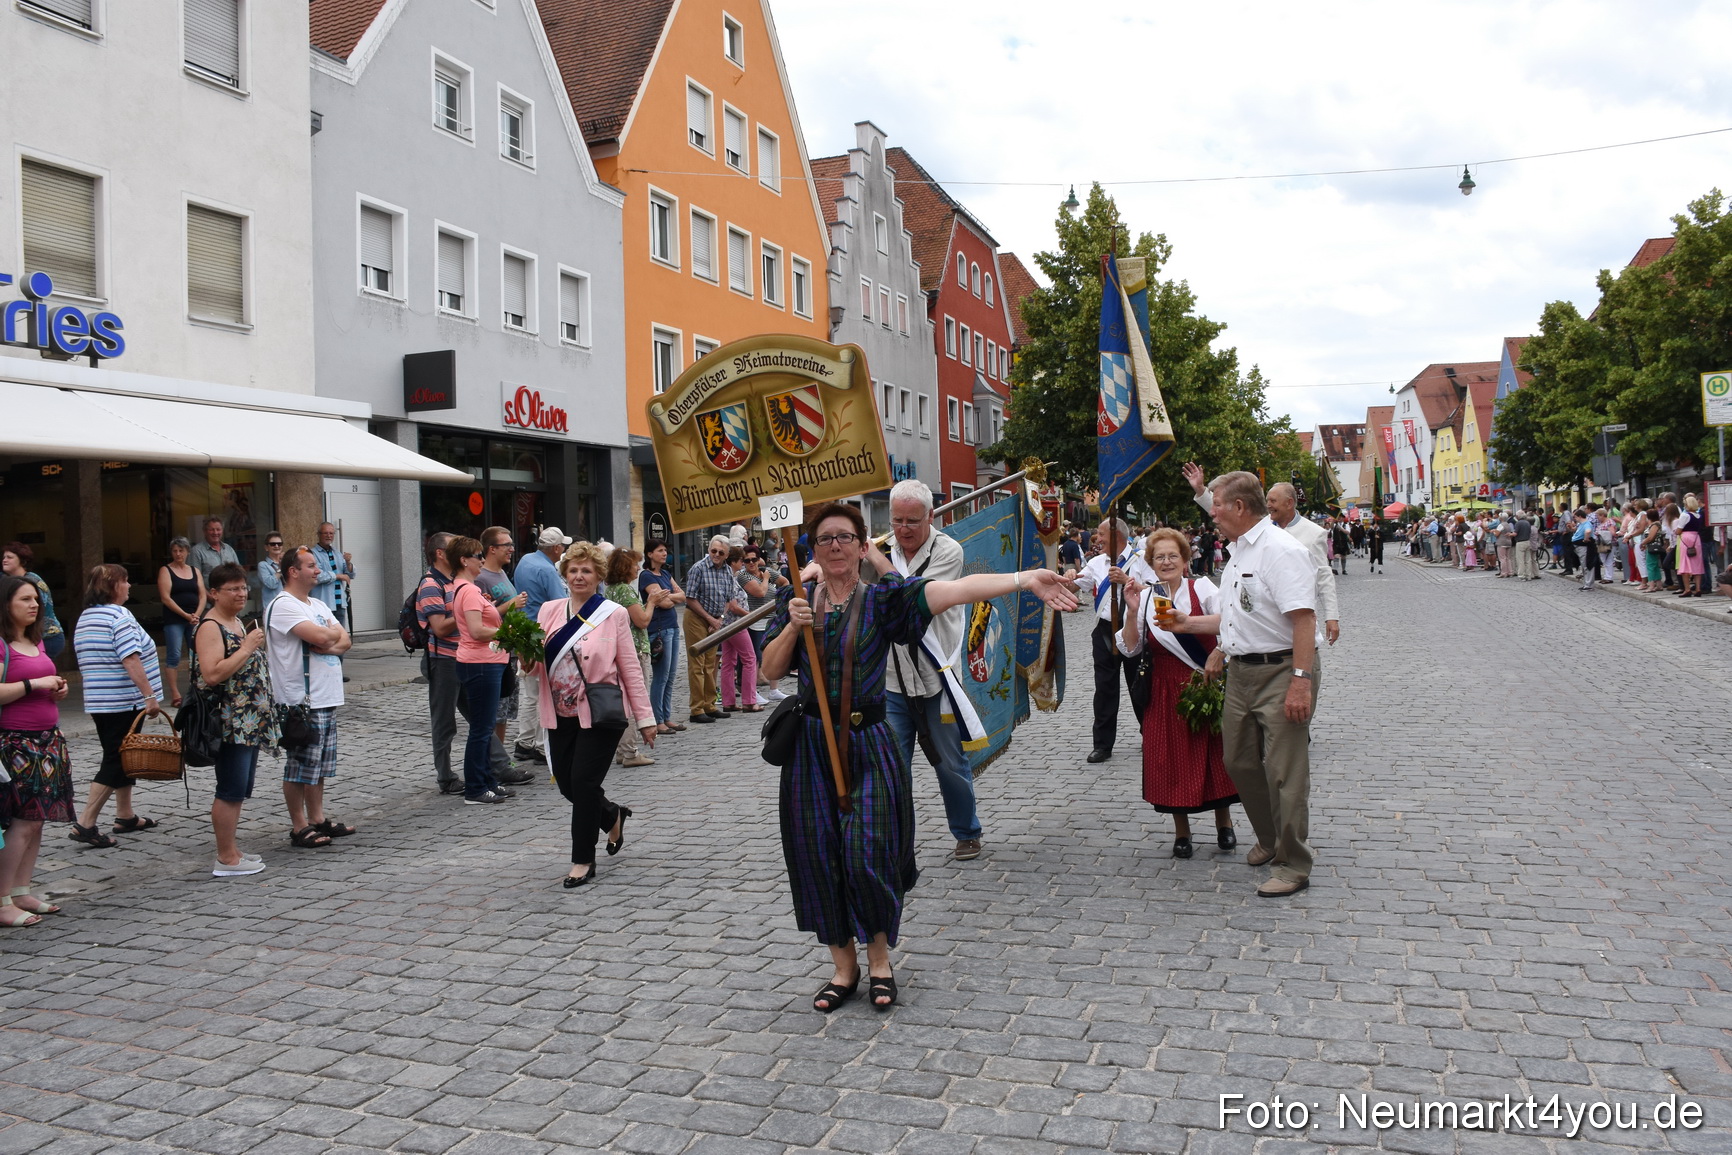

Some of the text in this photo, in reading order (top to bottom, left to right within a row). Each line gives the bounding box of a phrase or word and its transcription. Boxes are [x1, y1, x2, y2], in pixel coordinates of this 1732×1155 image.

[0, 271, 126, 358] ries
[410, 387, 447, 405] s.Oliver
[504, 385, 569, 432] s.Oliver
[667, 352, 834, 425] Oberpfälzer Heimatvereine
[672, 443, 876, 514] Nürnberg u. Röthenbach
[770, 505, 789, 522] 30
